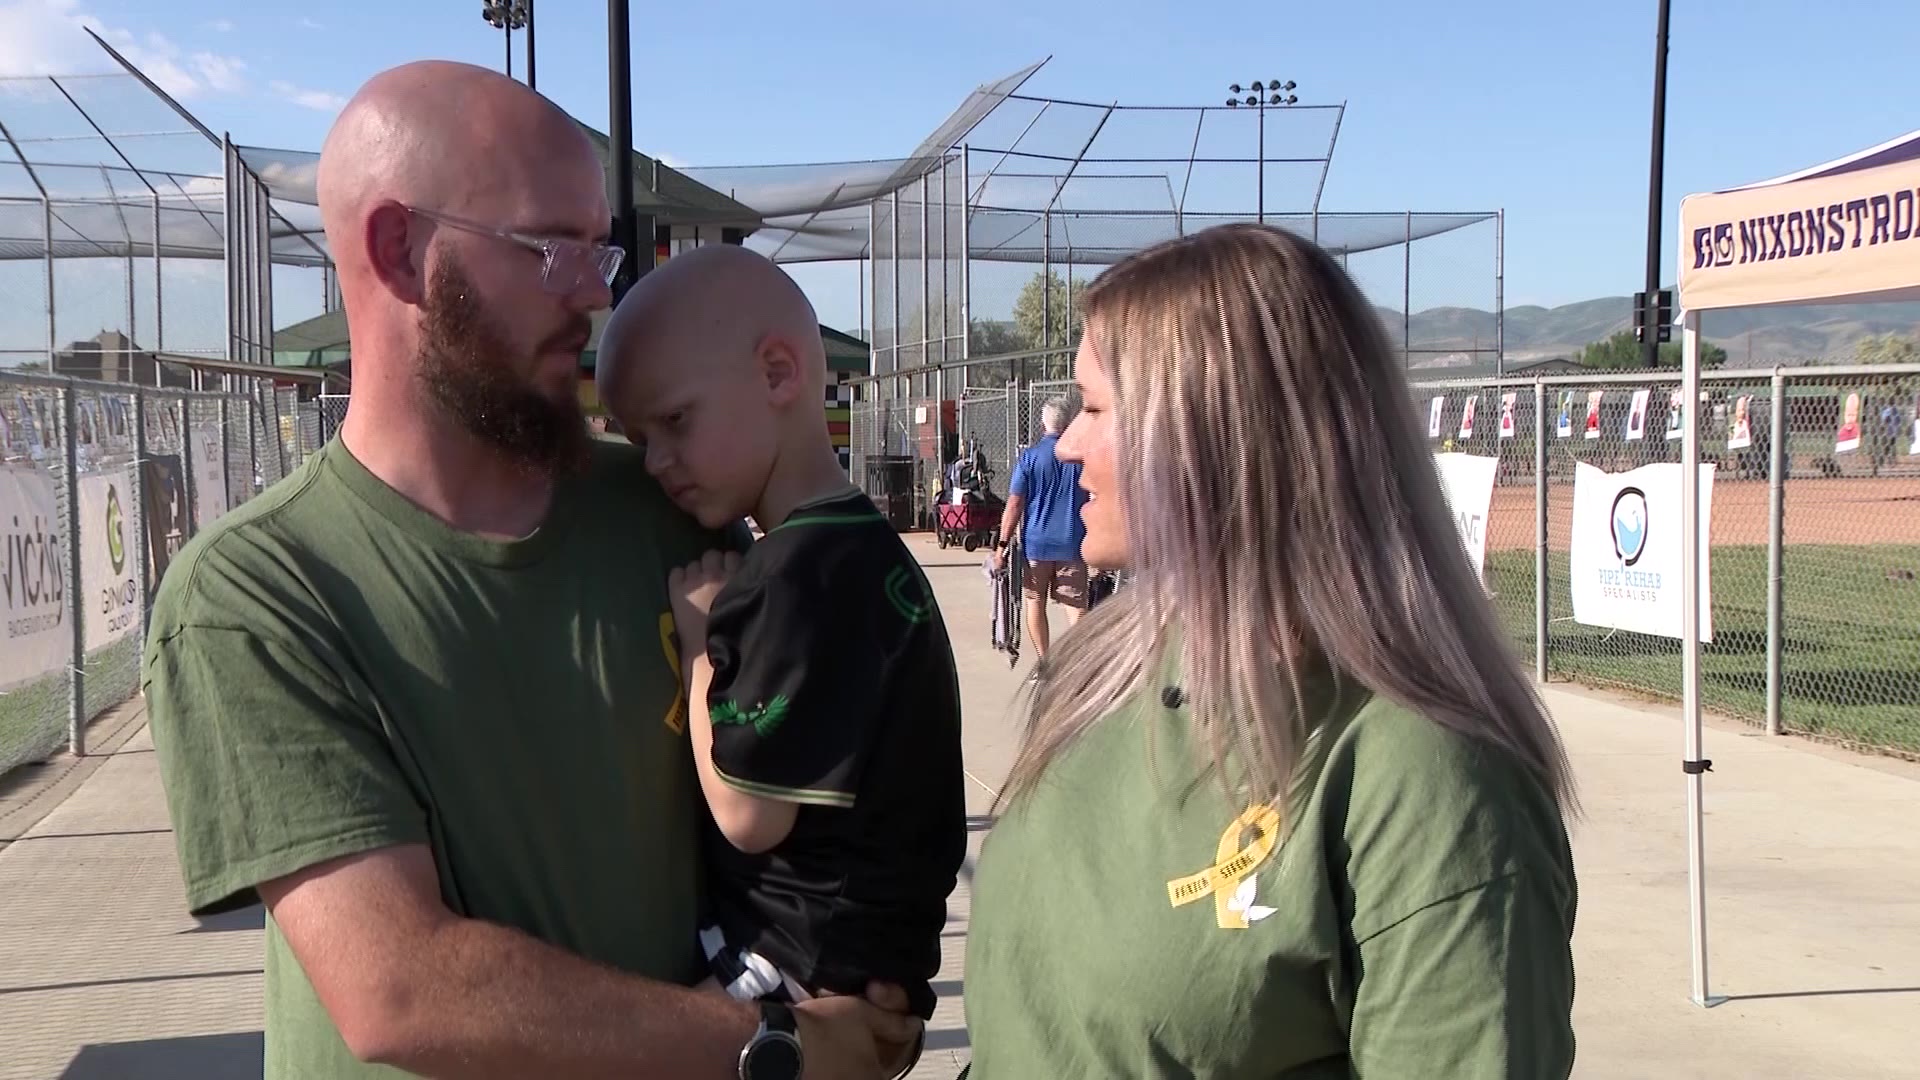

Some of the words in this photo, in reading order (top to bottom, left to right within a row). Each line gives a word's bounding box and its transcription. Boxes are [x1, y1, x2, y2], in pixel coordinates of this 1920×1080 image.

[1738, 189, 1920, 264] NIXONSTRO
[1598, 568, 1621, 586] PIPE
[1625, 570, 1662, 589] REHAB
